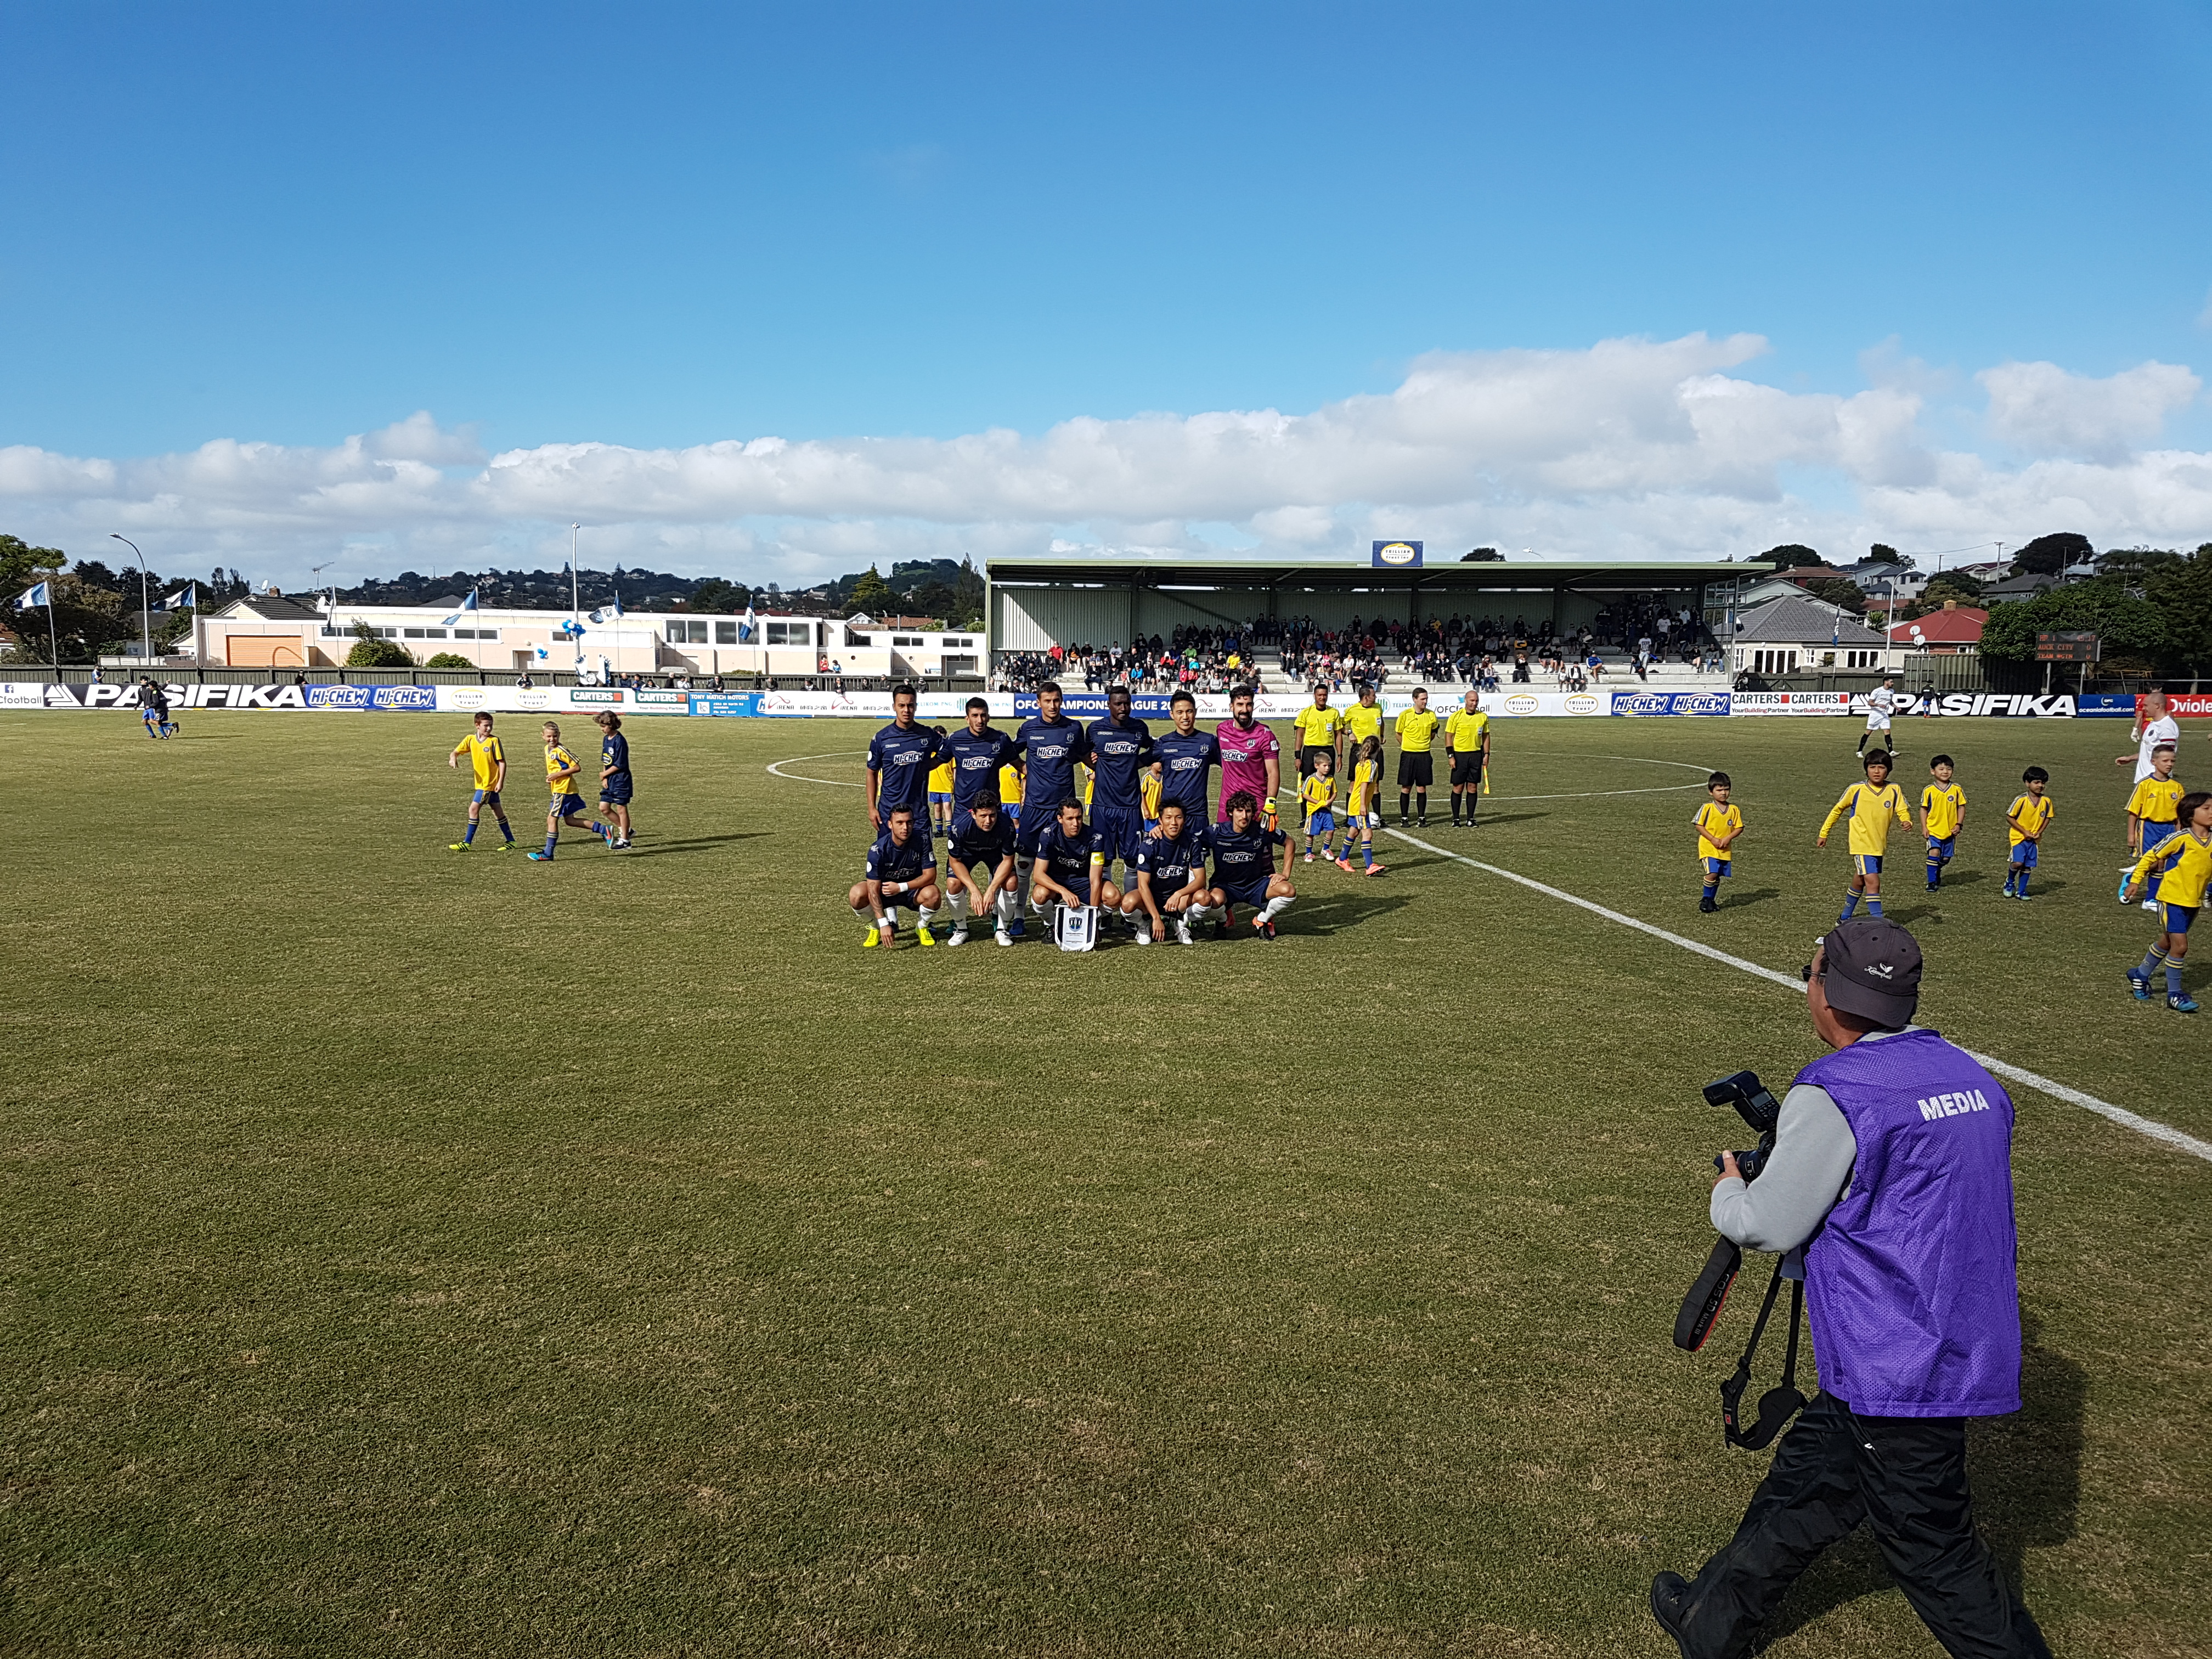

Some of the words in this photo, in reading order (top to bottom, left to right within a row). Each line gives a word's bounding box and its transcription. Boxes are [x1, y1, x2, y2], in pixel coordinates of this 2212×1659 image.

[84, 684, 306, 707] PASIFIKA
[311, 689, 370, 706] HI-CHEW
[375, 690, 434, 706] HI-CHEW
[573, 692, 613, 701] CARTERS
[637, 693, 678, 702] CARTERS
[1731, 694, 1780, 704] CARTERS
[1791, 694, 1838, 704] CARTERS
[1614, 696, 1669, 712] HI-CHEW
[1674, 696, 1729, 712] HI-CHEW
[1884, 693, 2077, 716] PASIFIKA
[1037, 747, 1068, 757] HI-CHEW
[1105, 743, 1137, 753] HI-CHEW
[894, 753, 923, 764] HI-CHEW
[1222, 750, 1248, 762] HI-CHEW
[962, 758, 994, 768] HI-CHEW
[1171, 759, 1201, 769] HI-CHEW
[1223, 853, 1255, 862] HI-CHEW
[1917, 1089, 1990, 1121] MEDIA
